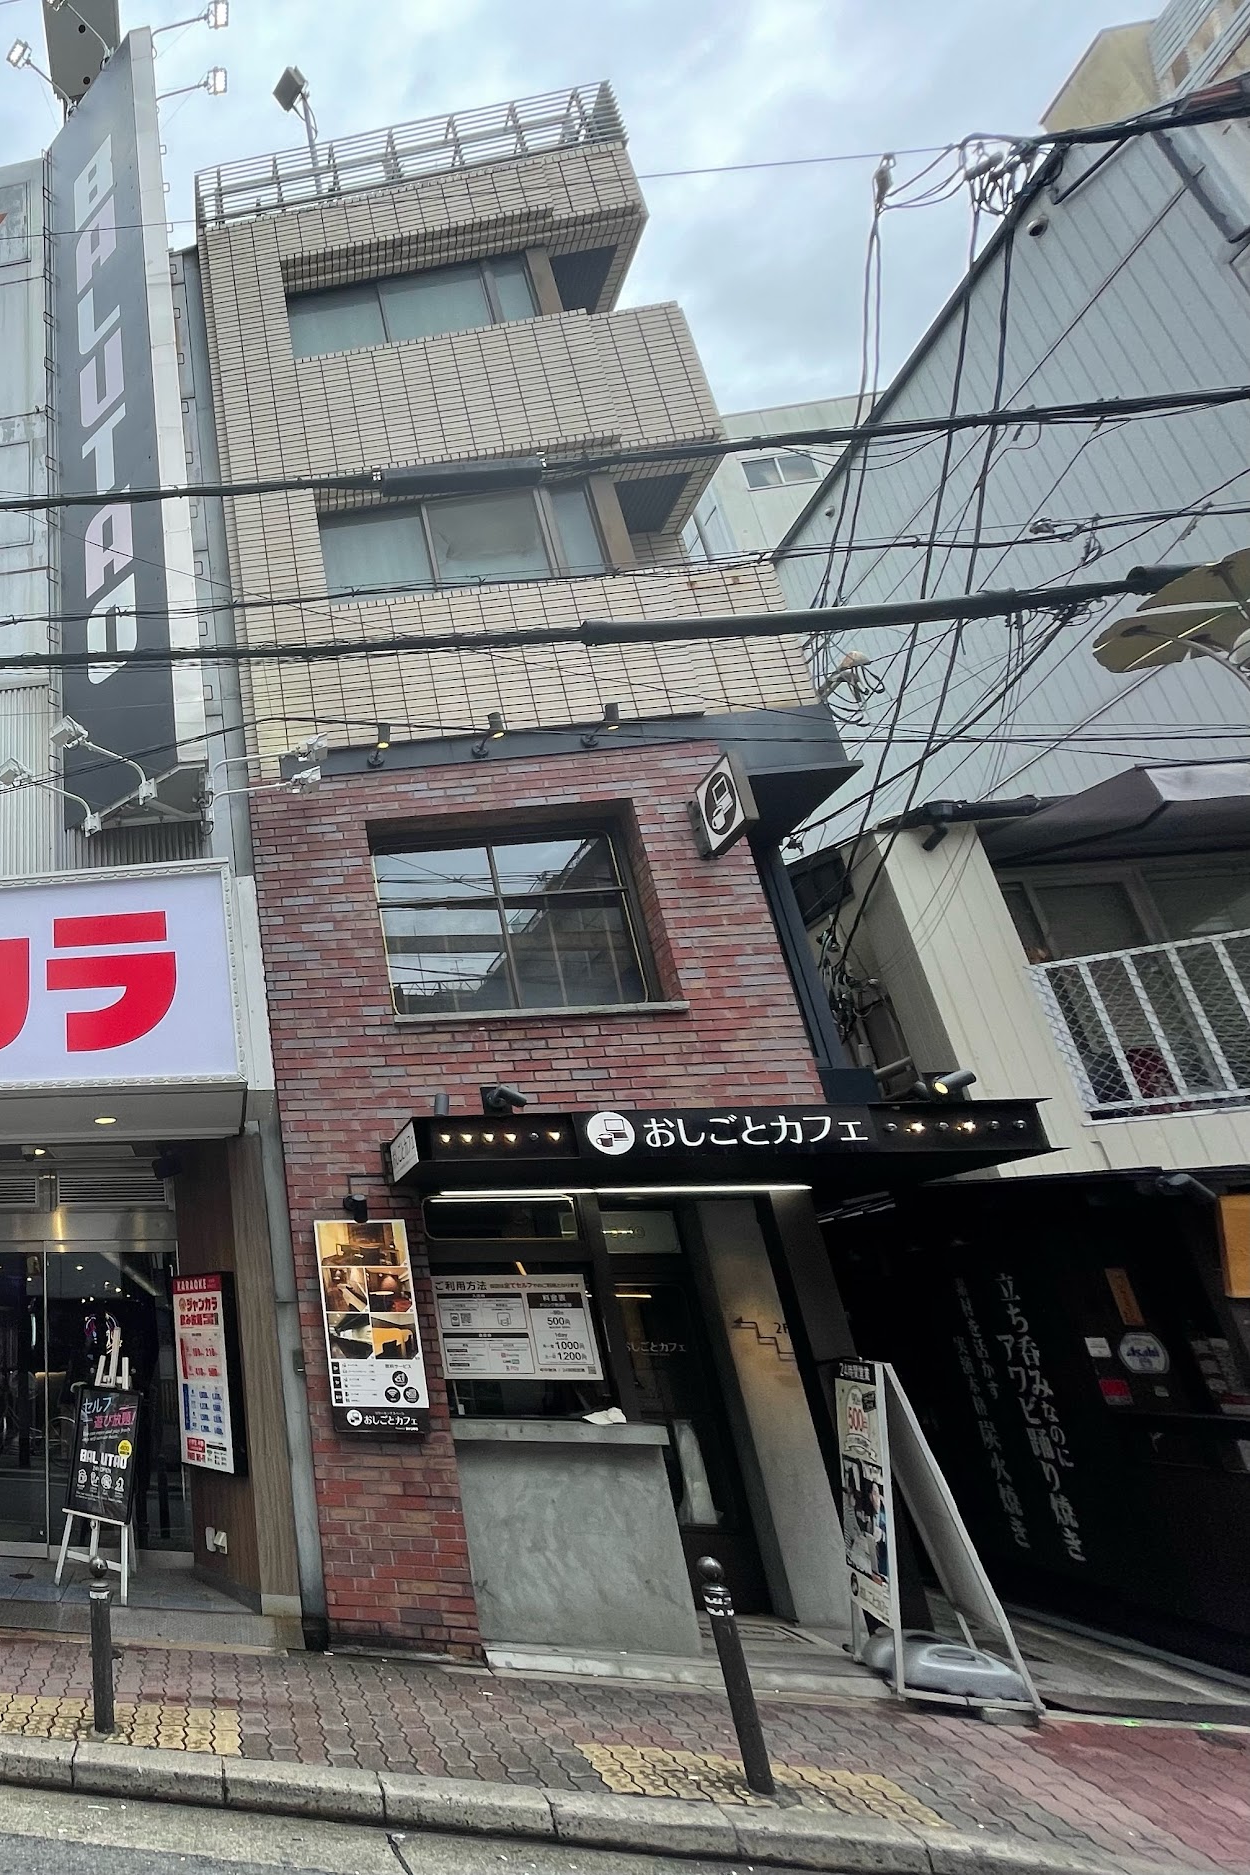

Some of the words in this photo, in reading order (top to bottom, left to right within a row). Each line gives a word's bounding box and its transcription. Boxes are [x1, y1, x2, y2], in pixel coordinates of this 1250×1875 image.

[643, 1113, 869, 1148] おしごとカフェ
[176, 1279, 207, 1291] KARAOKE
[435, 1281, 488, 1291] ご利用方法
[186, 1296, 217, 1312] ジャンカラ
[82, 1397, 113, 1414] セルフ
[363, 1415, 418, 1425] おしごとカフェ
[80, 1449, 99, 1464] BAL
[100, 1452, 127, 1470] UTAO
